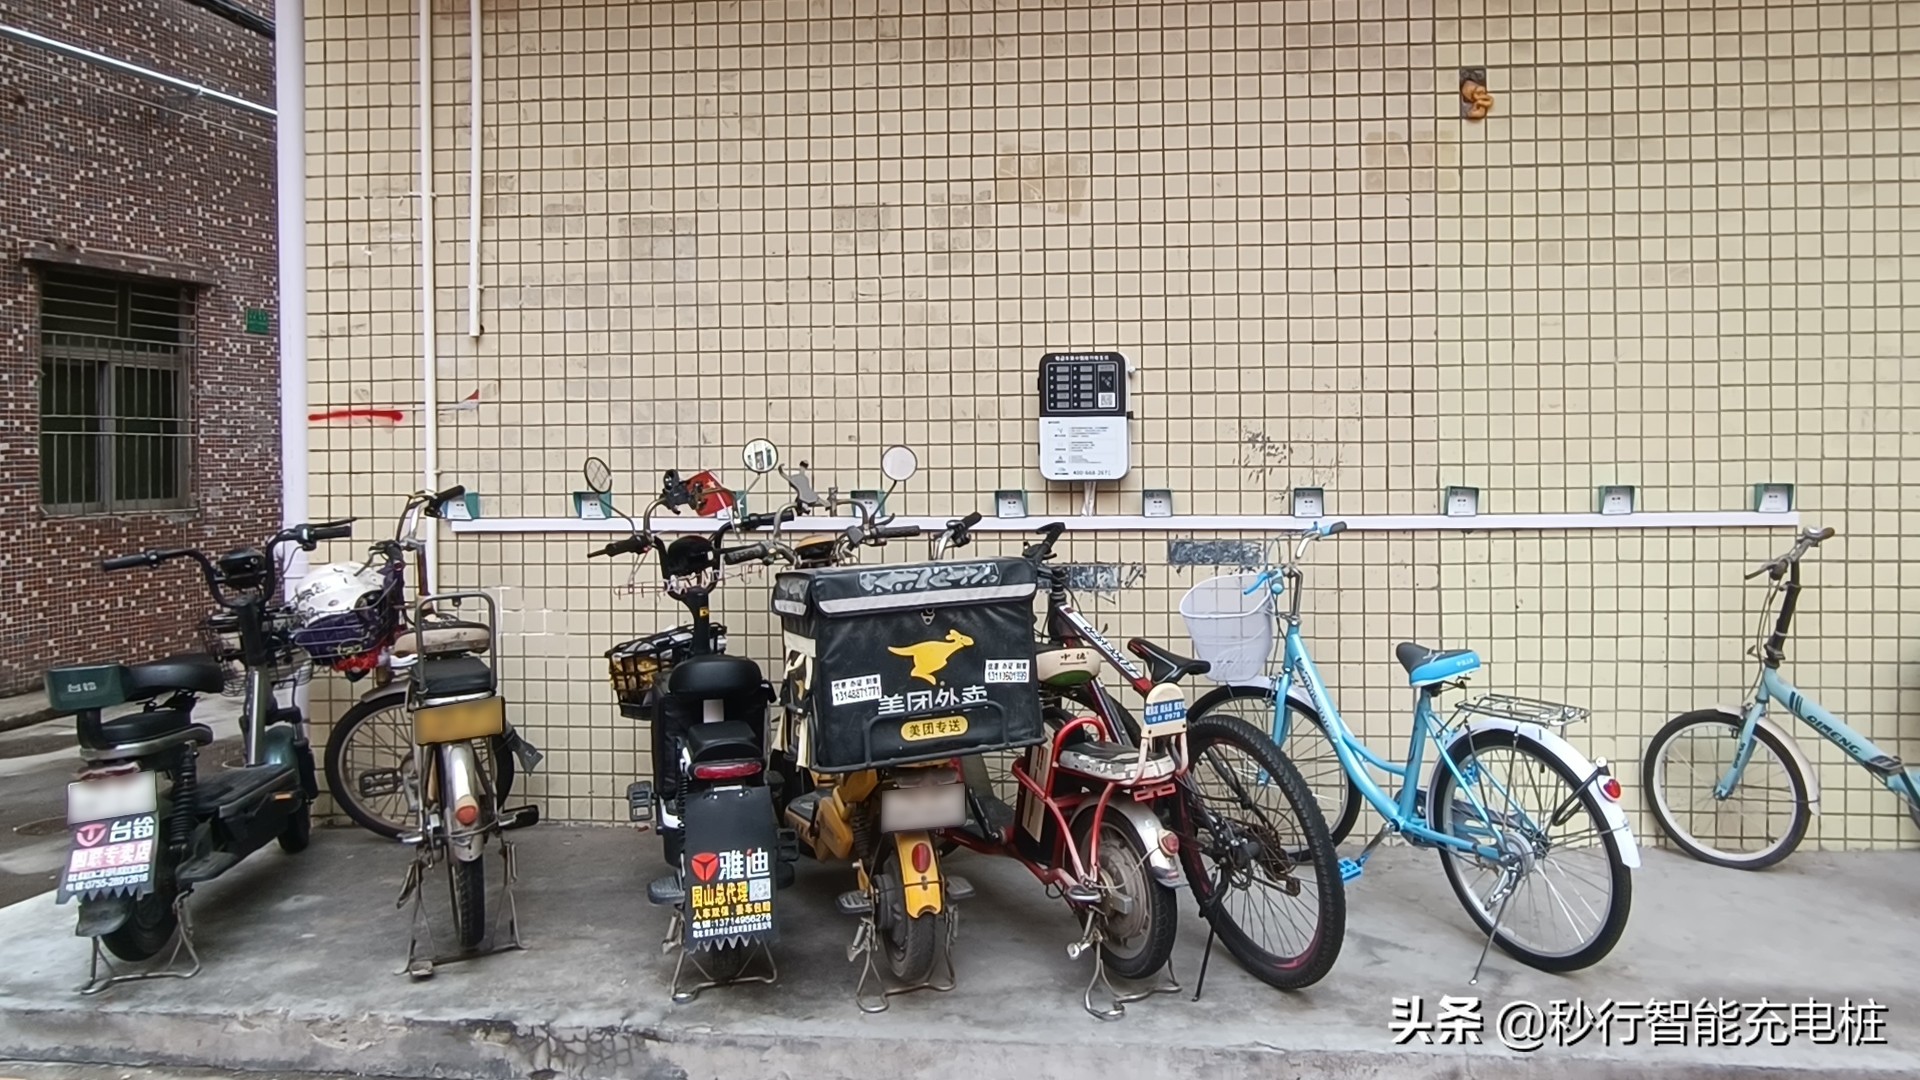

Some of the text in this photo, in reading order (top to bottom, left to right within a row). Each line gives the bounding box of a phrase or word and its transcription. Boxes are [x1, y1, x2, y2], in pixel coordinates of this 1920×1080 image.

[878, 684, 989, 717] 美团外卖
[909, 718, 962, 738] 美团专送
[109, 816, 154, 843] 台铃
[718, 847, 770, 881] 雅迪
